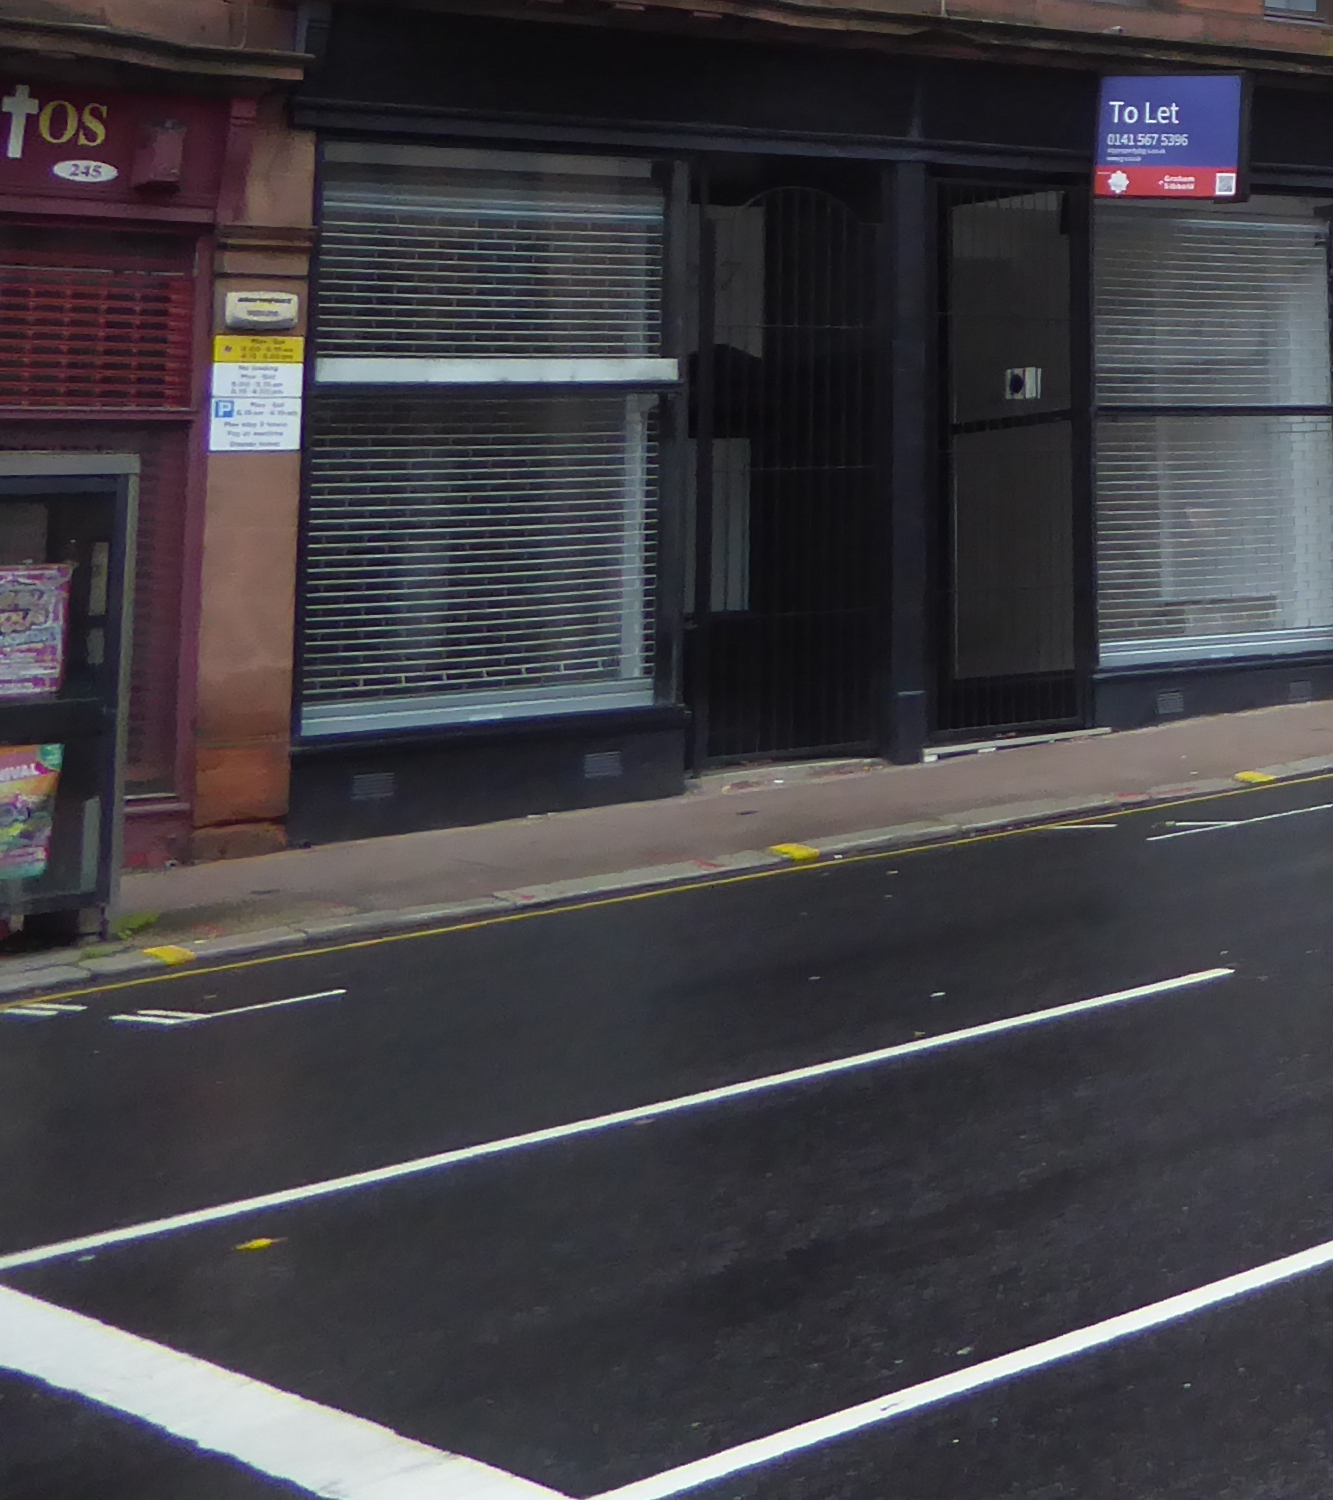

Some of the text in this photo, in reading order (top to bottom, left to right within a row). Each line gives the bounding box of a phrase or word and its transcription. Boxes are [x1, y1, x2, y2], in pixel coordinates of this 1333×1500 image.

[1108, 101, 1180, 124] To Let
[1106, 133, 1189, 146] 0141 567 5396
